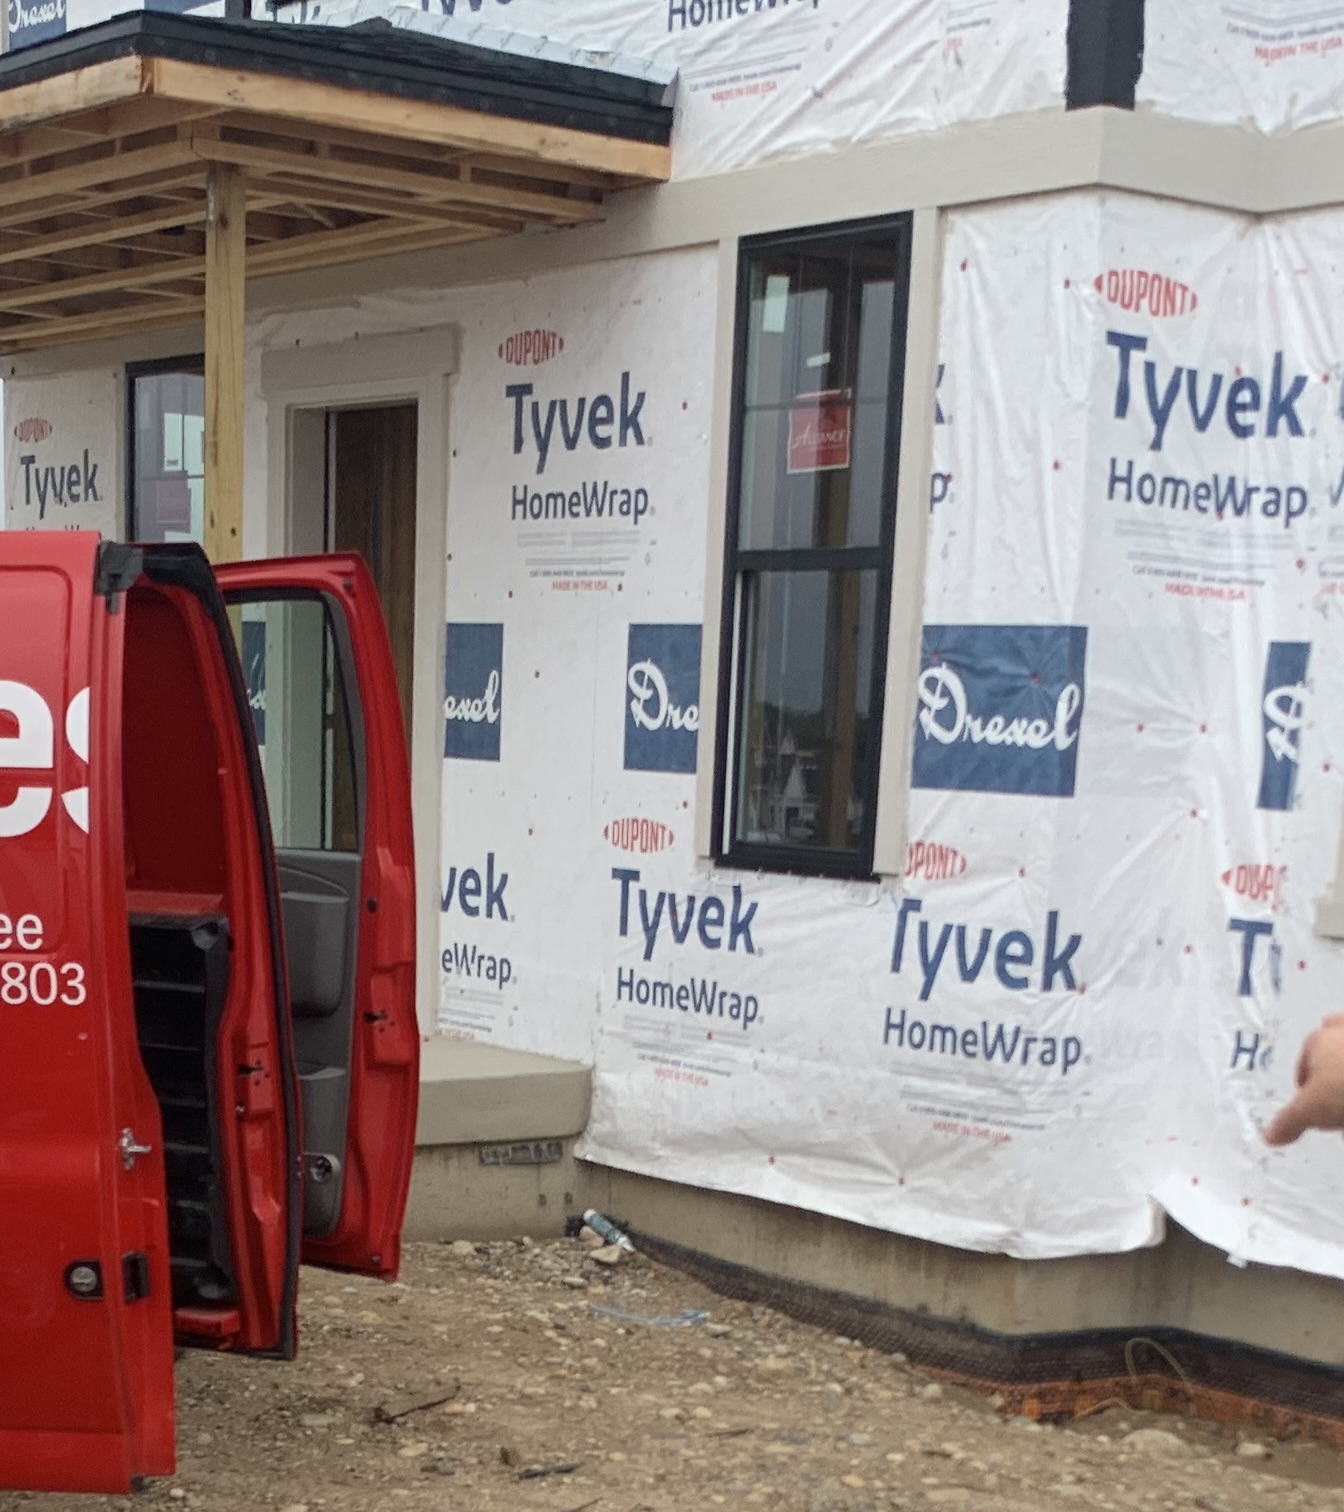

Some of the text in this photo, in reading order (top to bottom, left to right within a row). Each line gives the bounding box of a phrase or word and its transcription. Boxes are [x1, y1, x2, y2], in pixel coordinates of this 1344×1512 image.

[1106, 269, 1191, 318] DUPONT
[505, 328, 559, 366] DUPONT
[505, 371, 646, 475] Tyvek
[1106, 329, 1308, 452] Tyvek
[20, 448, 99, 520] Tyvek
[512, 480, 650, 526] HomeWrap
[1108, 456, 1308, 529] HomeWrap
[917, 661, 1081, 751] Drexel
[611, 817, 667, 854] DUPONT
[611, 867, 759, 961] Tyvek
[889, 897, 1083, 1002] Tyvek
[617, 966, 760, 1031] HomeWrap
[883, 1006, 1082, 1076] HomeWrap
